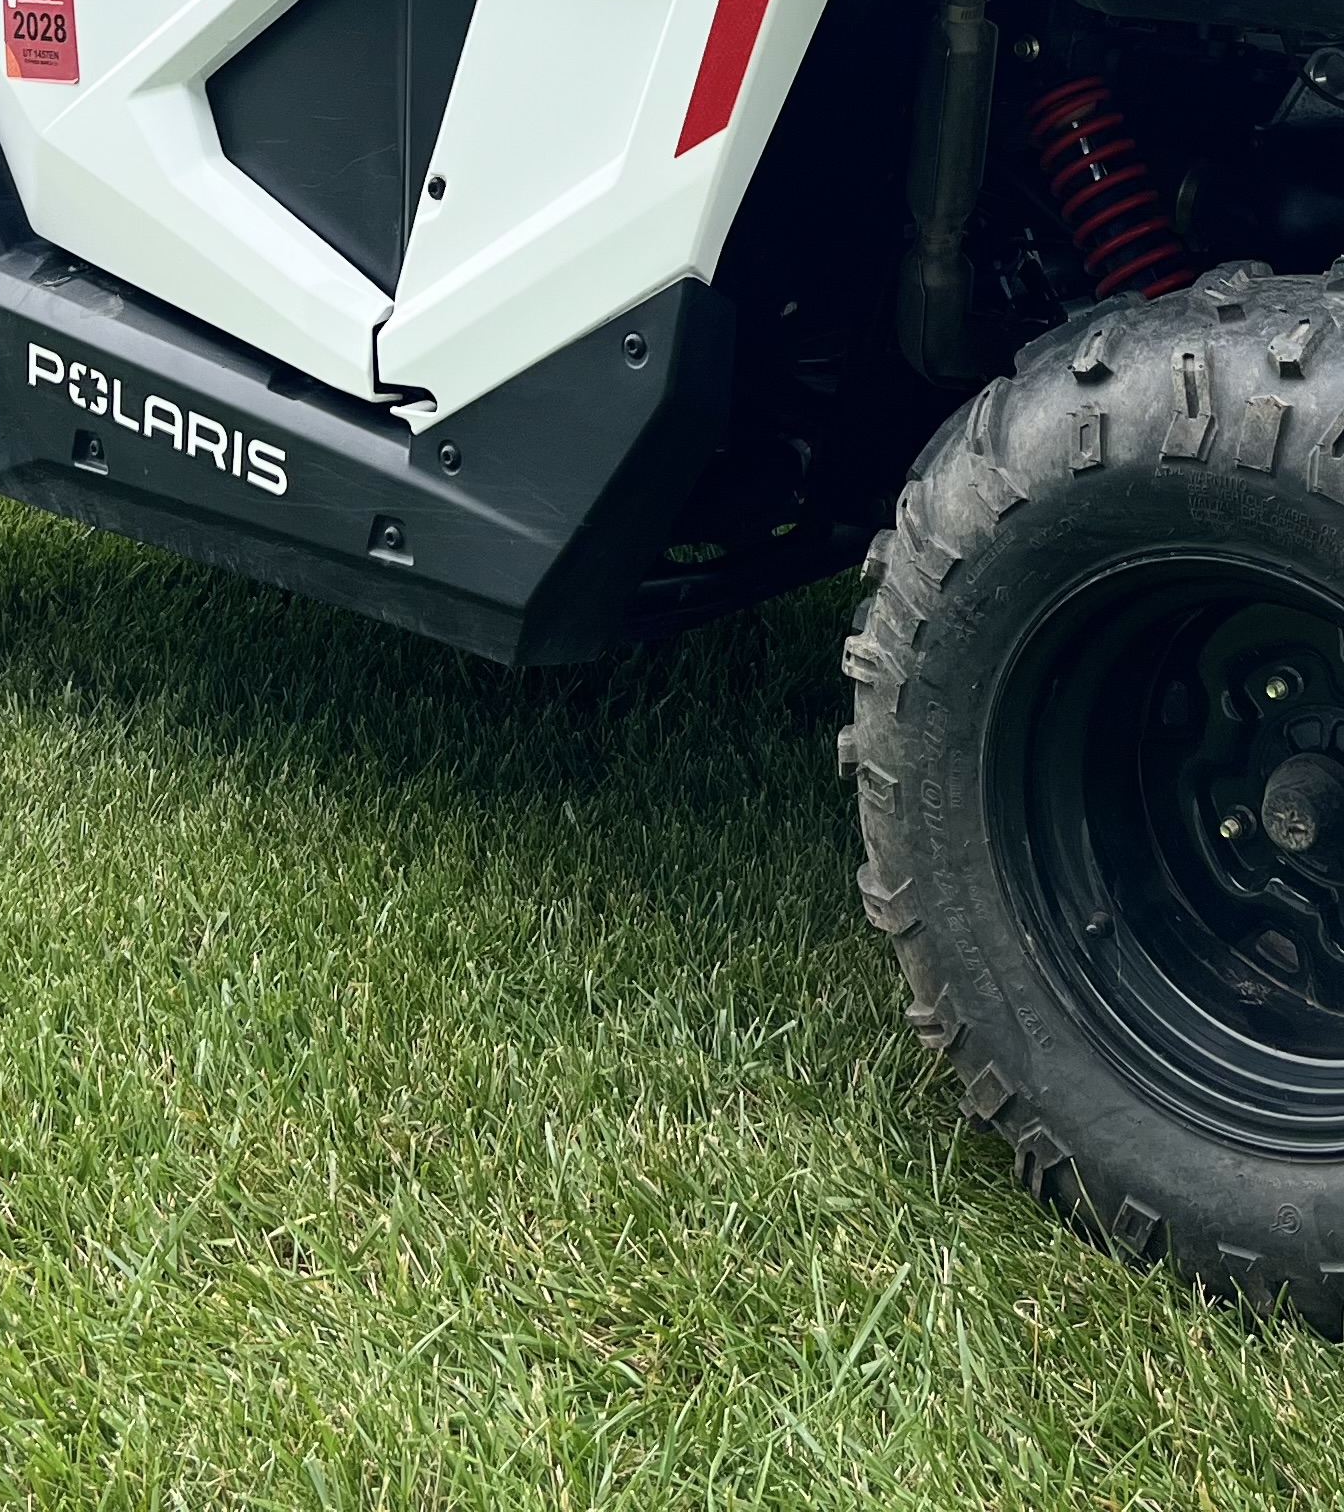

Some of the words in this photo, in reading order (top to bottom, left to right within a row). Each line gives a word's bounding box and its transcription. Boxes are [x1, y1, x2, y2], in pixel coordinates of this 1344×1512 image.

[12, 10, 67, 44] 2028
[22, 48, 33, 58] UT
[27, 342, 288, 497] POLARIS
